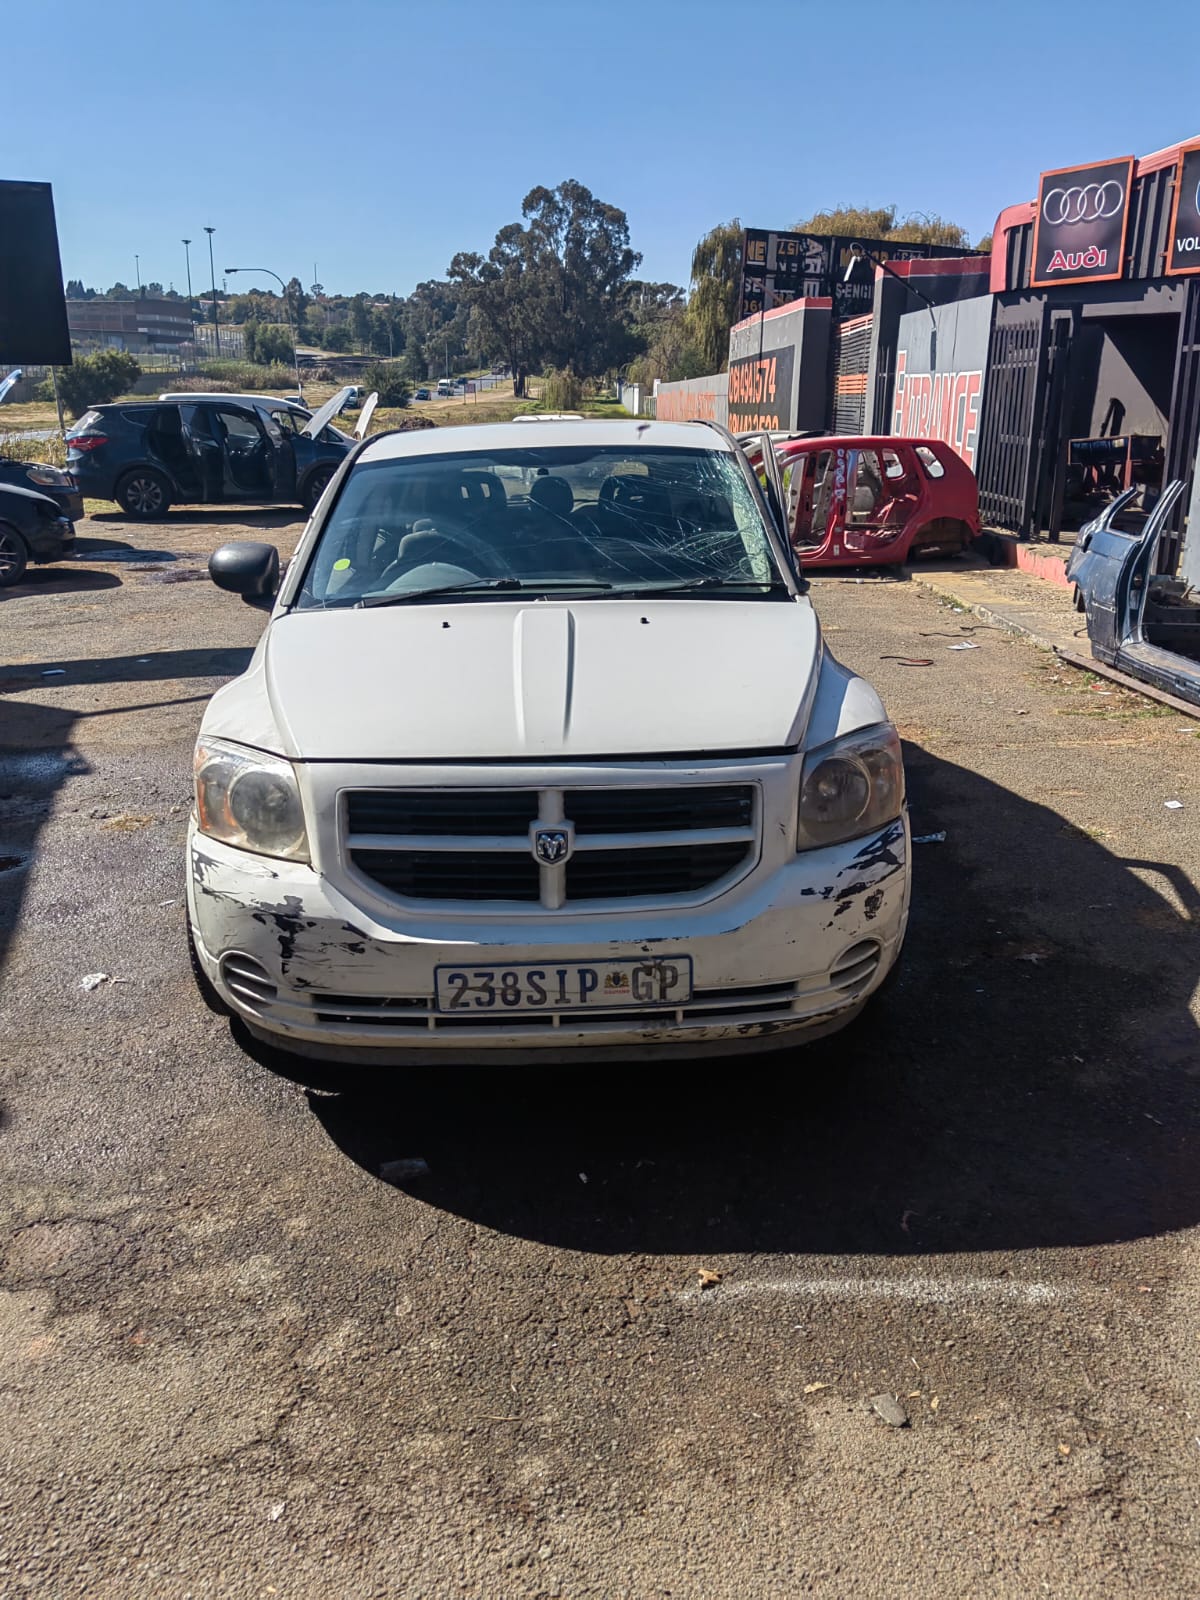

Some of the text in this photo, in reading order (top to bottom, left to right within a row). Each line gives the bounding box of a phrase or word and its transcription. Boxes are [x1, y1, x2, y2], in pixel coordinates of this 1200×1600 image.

[1046, 246, 1107, 273] Audi
[1177, 237, 1200, 252] VOL
[894, 350, 982, 474] ENTRANCE
[447, 964, 679, 1009] 238SIP GP
